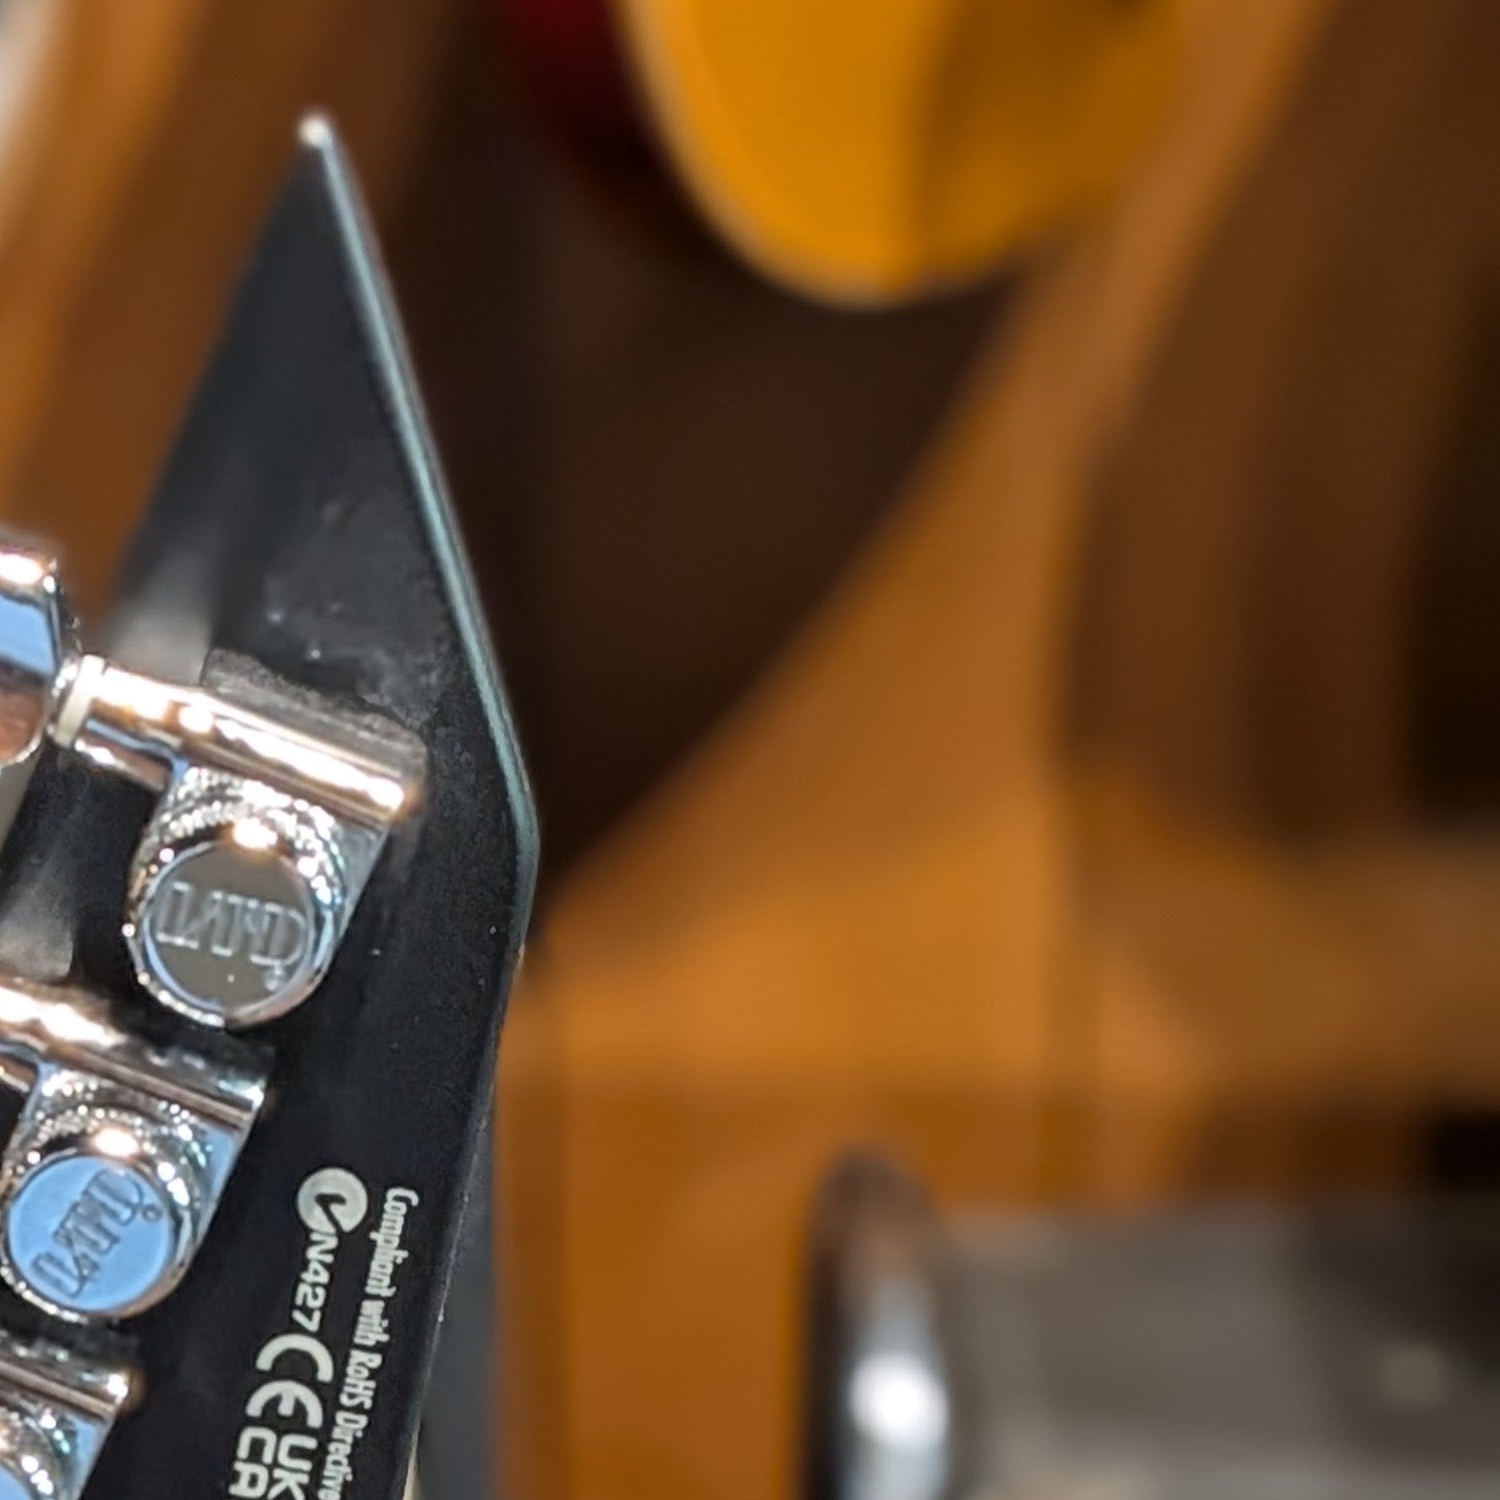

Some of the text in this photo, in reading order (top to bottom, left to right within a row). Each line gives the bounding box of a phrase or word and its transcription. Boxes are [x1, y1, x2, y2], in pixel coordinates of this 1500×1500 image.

[292, 1232, 338, 1332] N427
[365, 1187, 419, 1296] Compliant
[354, 1300, 389, 1345] with
[245, 1333, 333, 1428] CE
[340, 1348, 382, 1410] RoHS
[228, 1426, 277, 1498] CA
